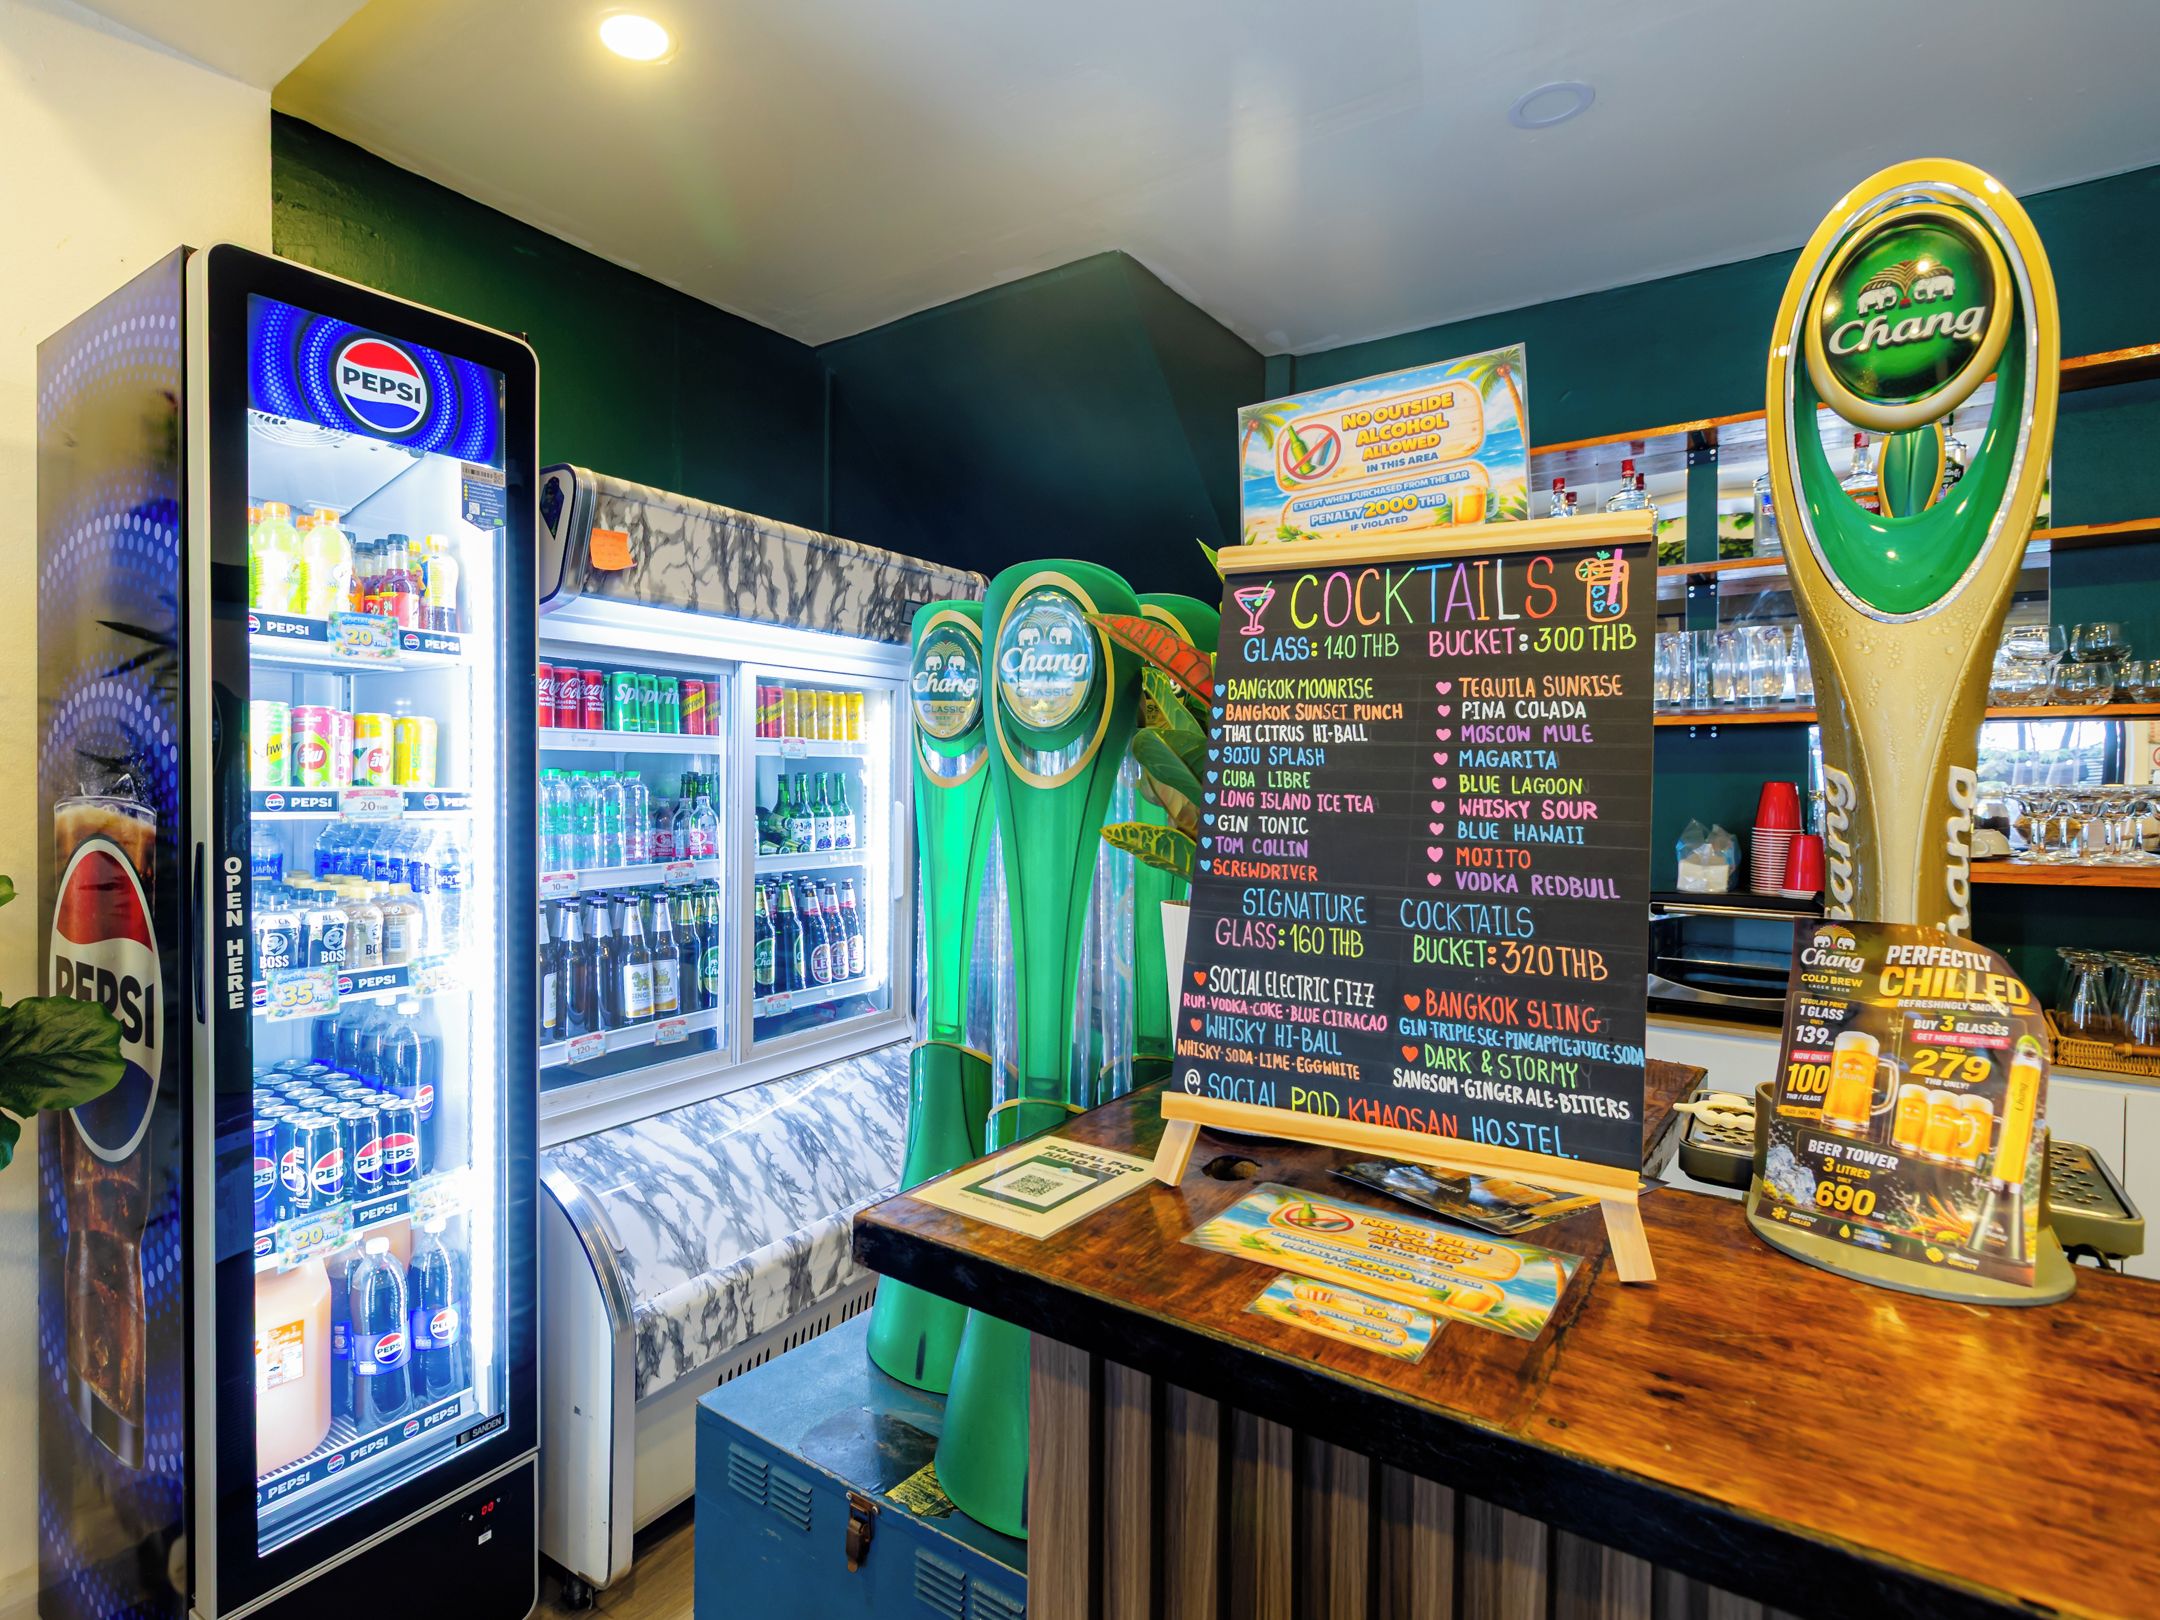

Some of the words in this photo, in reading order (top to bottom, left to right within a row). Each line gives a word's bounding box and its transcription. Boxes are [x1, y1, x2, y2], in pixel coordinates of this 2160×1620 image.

[1828, 306, 1986, 355] Chang
[343, 366, 421, 405] PEPSI
[1342, 413, 1370, 431] NO
[1373, 392, 1454, 423] OUTSIDE
[1356, 416, 1448, 447] ALCOHOL
[1363, 435, 1440, 461] ALLOWED
[1366, 464, 1379, 473] IN
[1381, 457, 1405, 471] THIS
[1408, 452, 1438, 466] AREA
[1293, 500, 1323, 512] EXCEPT
[1324, 494, 1350, 506] WHEN
[1351, 483, 1402, 500] PURCHASED
[1404, 479, 1428, 492] FROM
[1430, 476, 1447, 486] THE
[1448, 471, 1470, 483] BAR
[1310, 507, 1363, 527] PENALTY
[1364, 494, 1418, 517] 2000
[1419, 494, 1446, 507] THB
[1361, 515, 1408, 529] VIOLATED
[1291, 556, 1557, 629] COCKTAILS
[266, 621, 309, 636] PEPSI
[346, 630, 372, 645] 20
[1533, 628, 1585, 652] 300
[1589, 624, 1637, 651] THB
[425, 638, 459, 653] PEPSI
[1324, 637, 1356, 660] 140
[1361, 633, 1399, 658] THB
[1001, 647, 1088, 677] Chang
[912, 672, 978, 697] Chang
[1228, 680, 1293, 700] BANGKOK
[1298, 678, 1374, 699] MOONRISE
[1459, 676, 1536, 698] TEQUILA
[1543, 675, 1623, 697] SUNRISE
[922, 703, 965, 714] CLASSIC
[1225, 704, 1291, 721] BANGKOK
[1295, 703, 1349, 721] SUNSET
[1354, 703, 1403, 719] PUNCH
[1461, 701, 1502, 719] PINA
[1515, 701, 1586, 719] COLADA
[1223, 726, 1252, 743] THAI
[1254, 725, 1304, 743] CITRUS
[1312, 724, 1368, 742] HI-BALL
[1461, 725, 1530, 743] MOSCOW
[1543, 724, 1593, 743] MULE
[1223, 748, 1260, 765] SOJU
[1268, 748, 1325, 766] SPLASH
[1459, 750, 1557, 769] MAGARITA
[1222, 770, 1257, 788] CUBA
[1268, 771, 1311, 789] LIBRE
[1459, 775, 1499, 795] BLUE
[1511, 777, 1583, 796] LAGOON
[291, 797, 333, 808] PEPSI
[360, 801, 376, 811] 20
[1220, 790, 1255, 808] LONG
[1260, 793, 1312, 811] ISLAND
[1317, 794, 1341, 812] ICE
[1344, 794, 1374, 813] TEA
[1459, 799, 1530, 818] WHISKY
[1541, 801, 1598, 820] SOUR
[1217, 814, 1248, 833] GIN
[1259, 816, 1309, 835] TONIC
[1457, 822, 1499, 840] BLUE
[1514, 825, 1584, 845] HAWAII
[1215, 836, 1246, 854] TOM
[1252, 839, 1308, 859] COLLIN
[1456, 848, 1531, 869] MOJITO
[1213, 858, 1318, 882] SCREWDRIVER
[224, 857, 243, 927] OPEN
[552, 883, 561, 891] 10
[1455, 871, 1518, 894] VODKA
[1531, 875, 1620, 899] REDBULL
[1242, 888, 1367, 925] SIGNATURE
[1400, 898, 1534, 939] COCKTAILS
[1289, 927, 1324, 954] 160
[1328, 929, 1364, 958] THB
[259, 955, 289, 969] BOSS
[1500, 941, 1552, 975] 320
[1556, 946, 1608, 981] THB
[1801, 948, 1866, 973] Chang
[1885, 945, 1992, 972] PERFECTLY
[227, 939, 245, 1010] HERE
[358, 975, 396, 988] PEPSI
[1801, 974, 1828, 983] COLD
[1830, 975, 1863, 987] BREW
[1879, 966, 2031, 1006] CHILLED
[281, 983, 313, 1006] 35
[1209, 965, 1262, 997] SOCIAL
[1265, 971, 1330, 1003] ELECTRIC
[1334, 978, 1375, 1008] FIZZ
[1425, 988, 1519, 1026] BANGKOK
[1527, 1000, 1602, 1033] SLING
[1800, 1006, 1805, 1015] 1
[1808, 1006, 1844, 1020] GLASS
[1897, 999, 1968, 1011] REFRESHINGLY
[1206, 1014, 1266, 1044] WHISKY
[1275, 1024, 1342, 1056] HI-BALL
[1796, 1025, 1829, 1045] 139
[1913, 1019, 1939, 1030] BUY
[1940, 1015, 1955, 1032] 3
[1955, 1022, 2009, 1036] GLASSES
[576, 1045, 590, 1055] 120
[1425, 1043, 1472, 1074] DARK
[1481, 1050, 1493, 1076] &
[1498, 1053, 1579, 1089] STORMY
[1910, 1049, 1992, 1083] 279
[1787, 1063, 1830, 1094] 100
[1291, 1086, 1340, 1119] POD
[1045, 1145, 1104, 1164] SOCIAL
[1108, 1160, 1144, 1172] POD
[1807, 1139, 1844, 1159] BEER
[1846, 1147, 1899, 1171] TOWER
[1822, 1157, 1835, 1173] 3
[1835, 1164, 1871, 1180] LITRES
[1815, 1182, 1877, 1217] 690
[360, 1202, 398, 1221] PEPSI
[1361, 1217, 1397, 1230] NO
[295, 1227, 323, 1248] 20
[1387, 1248, 1415, 1258] THIS
[1346, 1257, 1414, 1280] 2000
[1363, 1304, 1388, 1319] 10
[1349, 1325, 1383, 1339] 30
[424, 1404, 459, 1428] PEPSI
[472, 1417, 502, 1438] SANDEN
[350, 1436, 389, 1462] PEPSI
[268, 1471, 310, 1500] PEPSI
